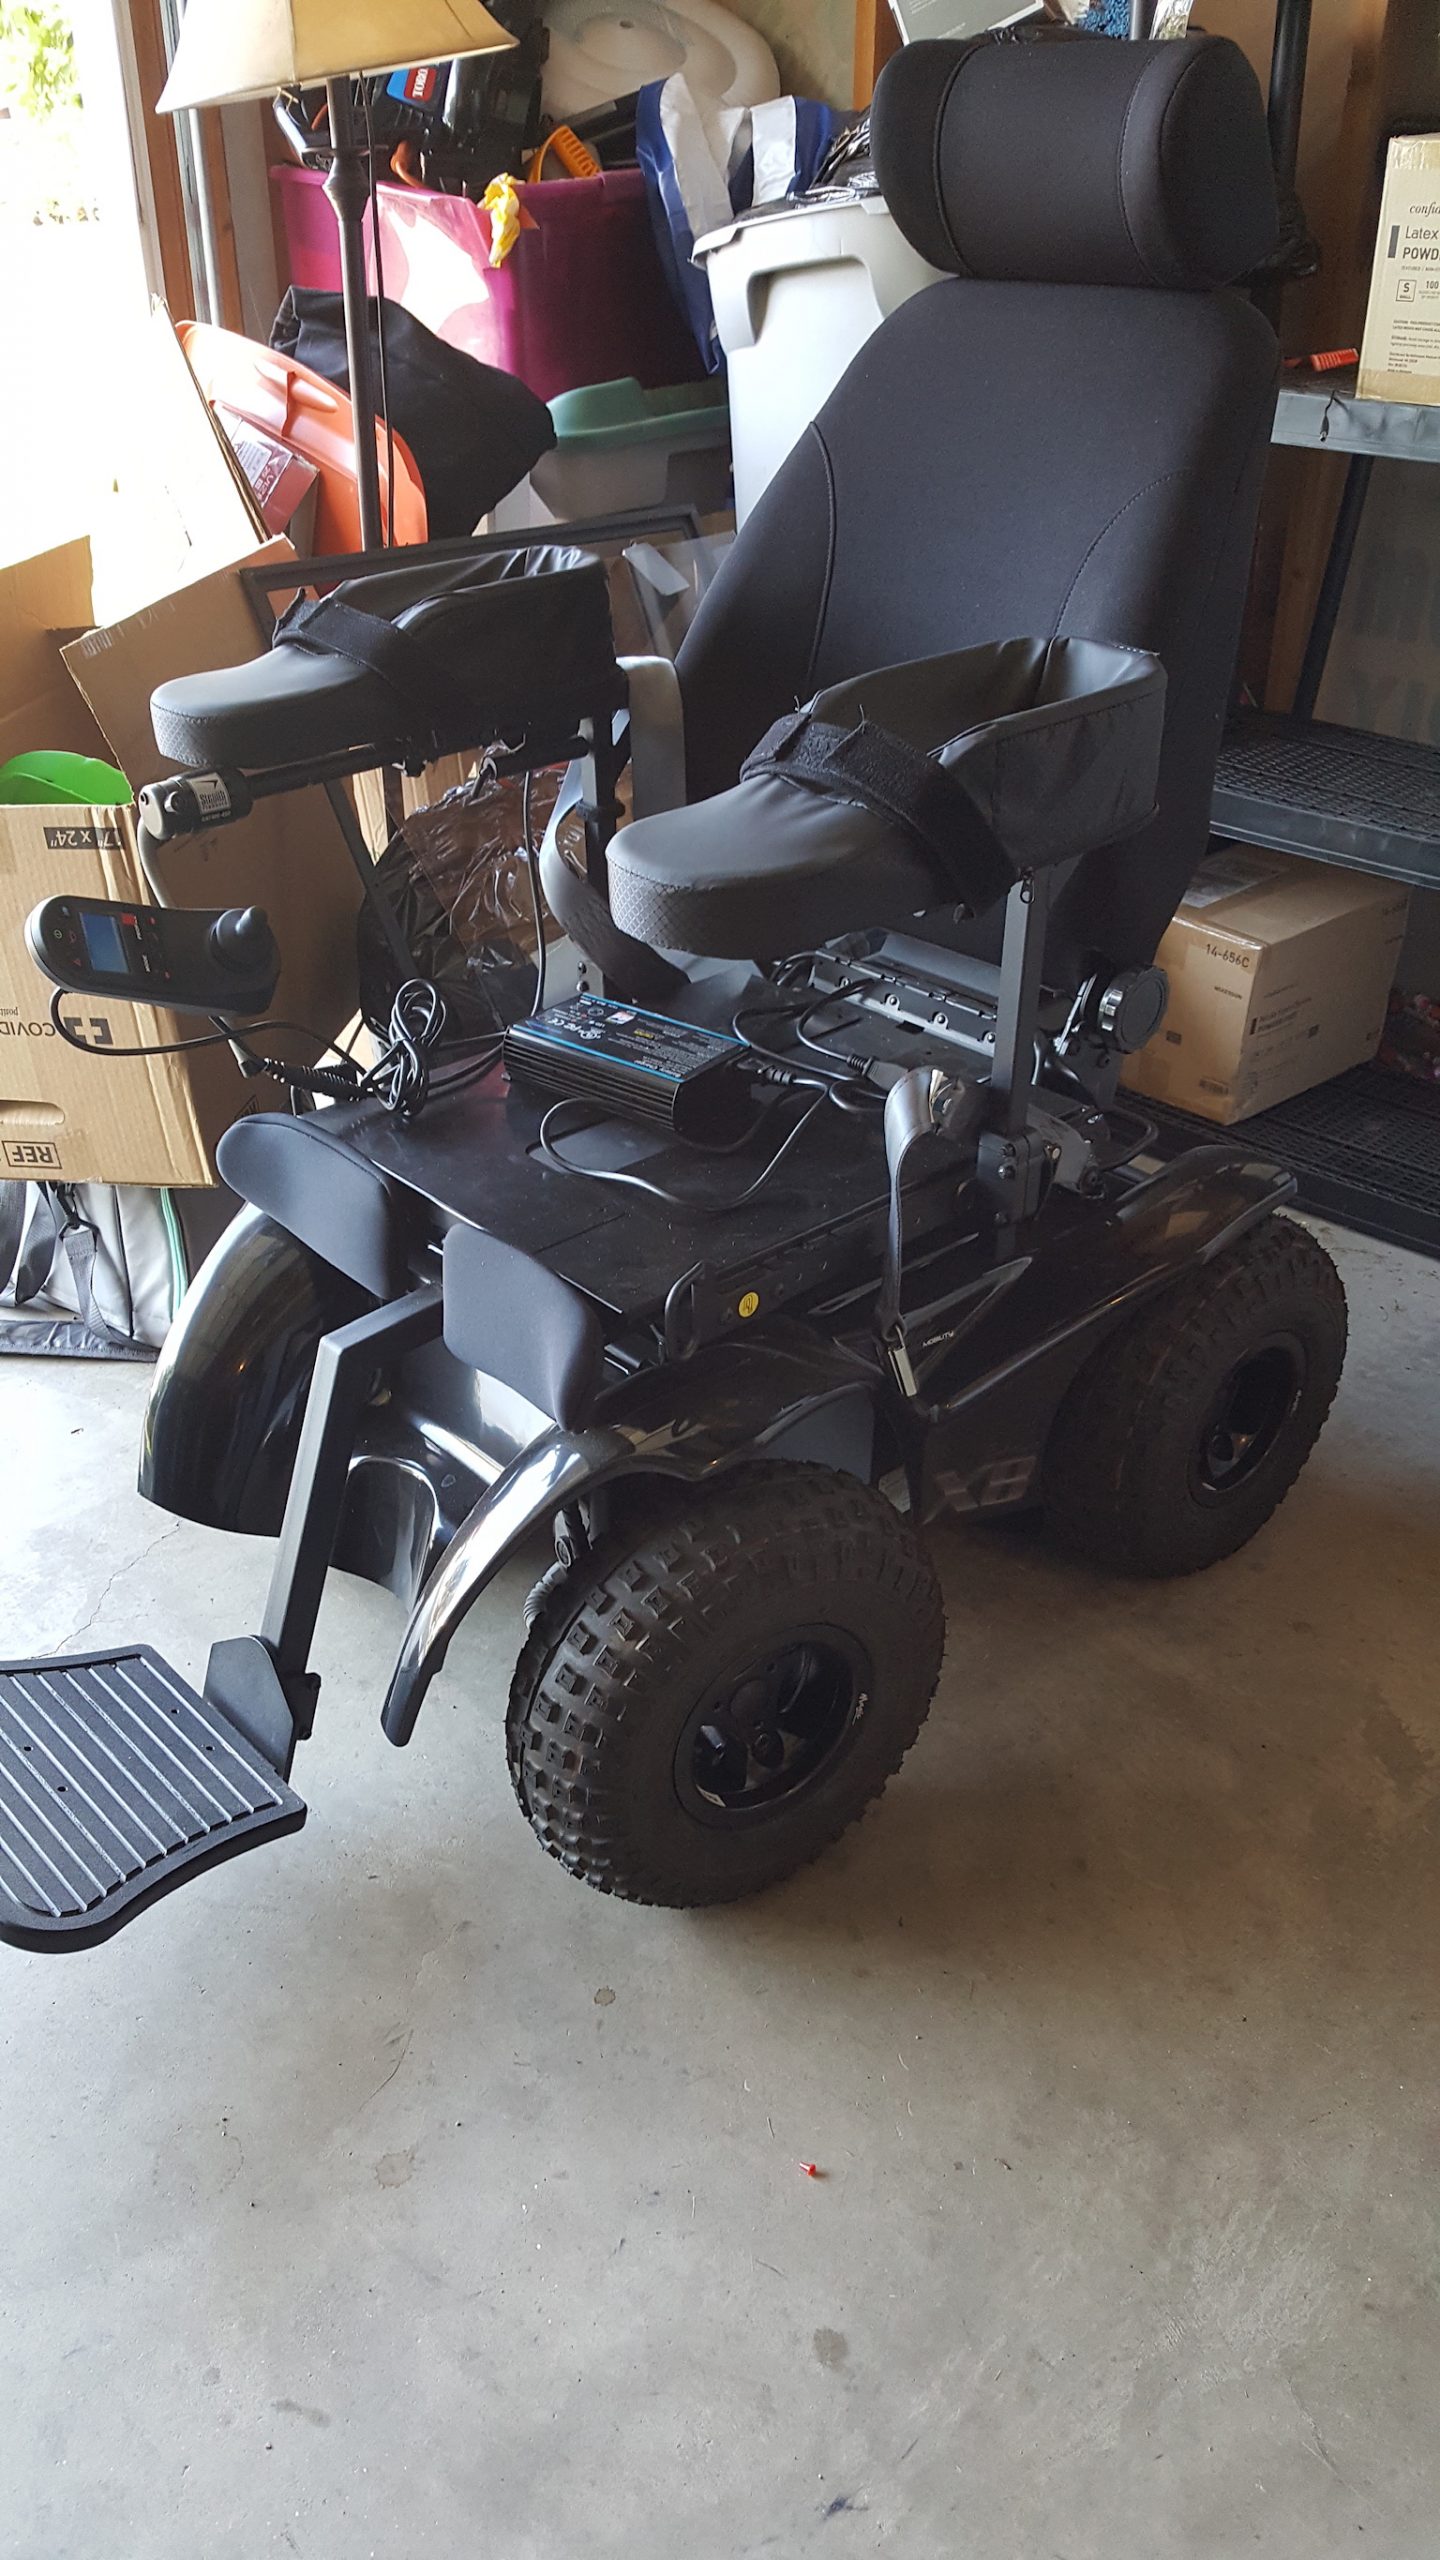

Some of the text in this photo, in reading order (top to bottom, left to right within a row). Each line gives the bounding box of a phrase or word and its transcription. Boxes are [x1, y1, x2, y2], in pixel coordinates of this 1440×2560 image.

[412, 67, 429, 98] TORO
[1405, 225, 1439, 240] Latex
[1402, 246, 1440, 260] POWD
[1403, 282, 1410, 293] S
[1426, 280, 1439, 290] 100
[50, 830, 78, 847] 24"
[1206, 943, 1250, 968] 14-656C
[0, 1021, 56, 1037] COVID
[12, 1145, 54, 1164] REF
